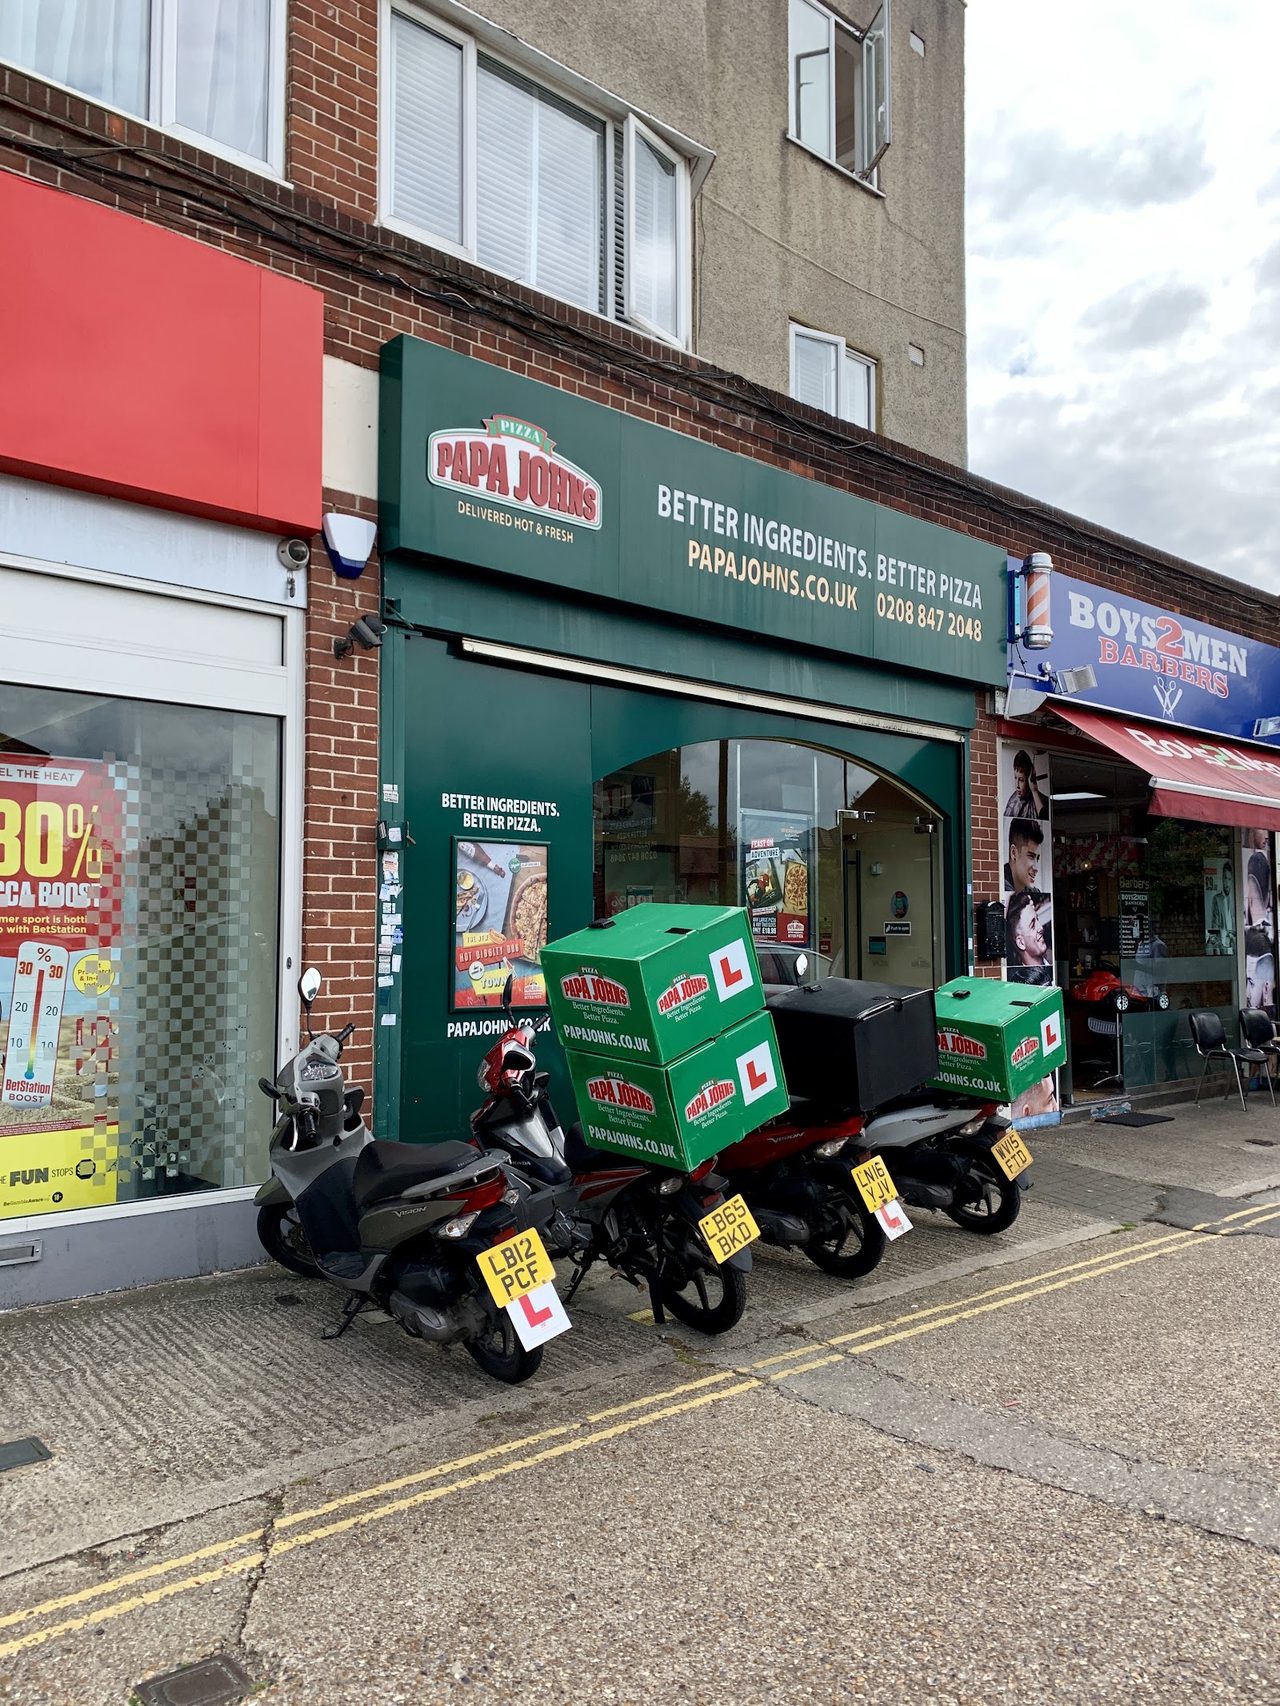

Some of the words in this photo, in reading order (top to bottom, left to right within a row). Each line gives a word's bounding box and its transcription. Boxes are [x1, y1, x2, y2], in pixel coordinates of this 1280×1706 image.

[500, 418, 541, 443] PIZZA
[437, 440, 510, 496] PAPA
[457, 500, 512, 527] DELIVERED
[514, 519, 534, 534] HOT
[535, 525, 543, 534] &
[545, 525, 574, 543] FRESH
[657, 484, 739, 539] BETTER
[743, 512, 872, 579] INGREDIENTS.
[877, 554, 937, 596] BETTER
[940, 573, 983, 610] PIZZA
[688, 539, 858, 611] PAPAJOHNS.CO.UK
[876, 592, 914, 625] 0208
[917, 607, 944, 632] 847
[948, 612, 983, 642] 2048
[1069, 591, 1248, 677] BOYS2MEN
[1098, 635, 1229, 699] BARBERS
[17, 769, 40, 779] THE
[45, 771, 75, 782] HEAT
[442, 793, 485, 811] BETTER
[486, 796, 560, 817] INGREDIENTS.
[463, 813, 505, 830] BETTER
[506, 816, 542, 833] PIZZA.
[752, 849, 777, 858] ADVENTURE
[7, 925, 29, 933] with
[33, 925, 87, 934] BetStation
[22, 916, 49, 926] sport
[37, 947, 52, 962] %
[460, 951, 472, 963] HOT
[476, 946, 503, 960] DIGGITY
[507, 943, 520, 954] DOG
[19, 961, 33, 975] 30
[49, 964, 63, 979] 30
[581, 967, 598, 975] PIZZA
[720, 957, 743, 988] L
[481, 976, 508, 989] TOWN
[563, 977, 591, 1000] PAPA
[591, 977, 628, 1007] JOHNS
[659, 988, 681, 1013] PAPA
[681, 976, 709, 998] JOHNS
[15, 1002, 28, 1012] 20
[45, 1005, 58, 1016] 20
[572, 1001, 590, 1011] Better
[590, 1003, 626, 1018] Ingredients.
[583, 1011, 601, 1022] Better
[601, 1015, 619, 1025] Pizza.
[666, 1009, 680, 1019] Better
[675, 1012, 688, 1023] Better
[10, 1037, 23, 1048] 10
[563, 1024, 651, 1052] PAPAJOHNS.CO.UK
[951, 1034, 985, 1058] JOHNS
[1045, 1024, 1057, 1047] L
[1012, 1046, 1025, 1064] PAPA
[6, 1079, 51, 1094] BetStation
[746, 1060, 767, 1092] L
[935, 1071, 1001, 1093] JOHNS.CO.UK
[9, 1093, 44, 1103] BOOST
[588, 1080, 617, 1106] PAPA
[617, 1082, 654, 1114] JOHNS
[597, 1103, 615, 1114] Better
[687, 1096, 709, 1120] PAPA
[709, 1081, 734, 1106] JOHNS
[608, 1113, 626, 1125] Better
[693, 1114, 709, 1127] Better
[701, 1117, 716, 1129] Better
[588, 1124, 677, 1159] PAPAJOHNS.CO.UK
[1005, 1149, 1027, 1174] FTD
[9, 1167, 49, 1187] FUN
[51, 1167, 74, 1178] STOPS
[856, 1163, 885, 1188] LN16
[866, 1178, 890, 1203] YJV
[393, 1206, 427, 1217] VISION
[701, 1199, 747, 1241] LB65
[881, 1204, 902, 1229] L
[717, 1221, 752, 1257] BKD
[488, 1237, 536, 1276] LB12
[501, 1260, 538, 1297] PCF
[518, 1294, 553, 1329] L
